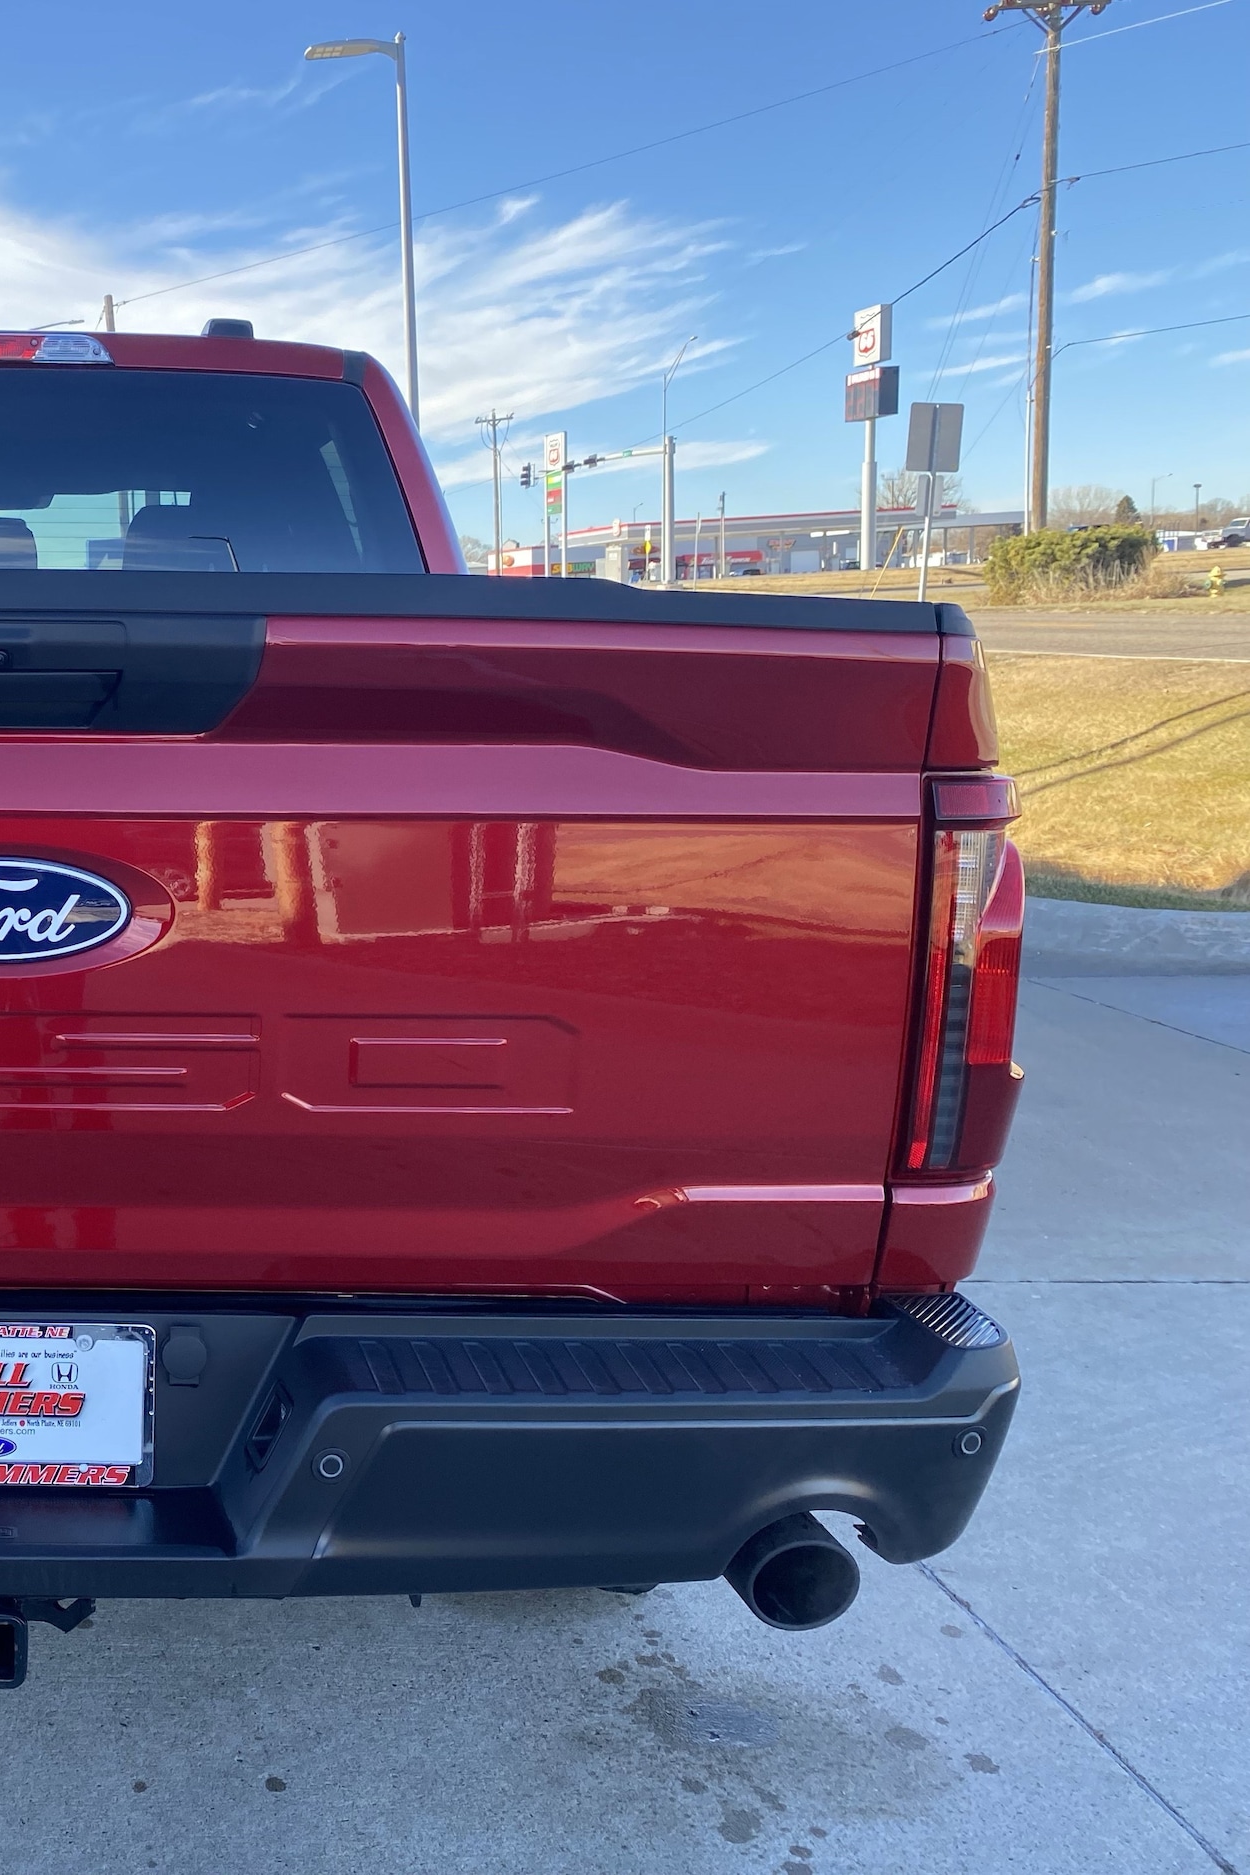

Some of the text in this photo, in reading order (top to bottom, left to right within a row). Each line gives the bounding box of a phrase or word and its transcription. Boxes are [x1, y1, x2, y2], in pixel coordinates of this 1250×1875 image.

[44, 1326, 70, 1338] NE
[18, 1351, 28, 1359] are
[30, 1351, 42, 1359] our
[26, 1420, 40, 1428] North
[56, 1420, 64, 1428] NE
